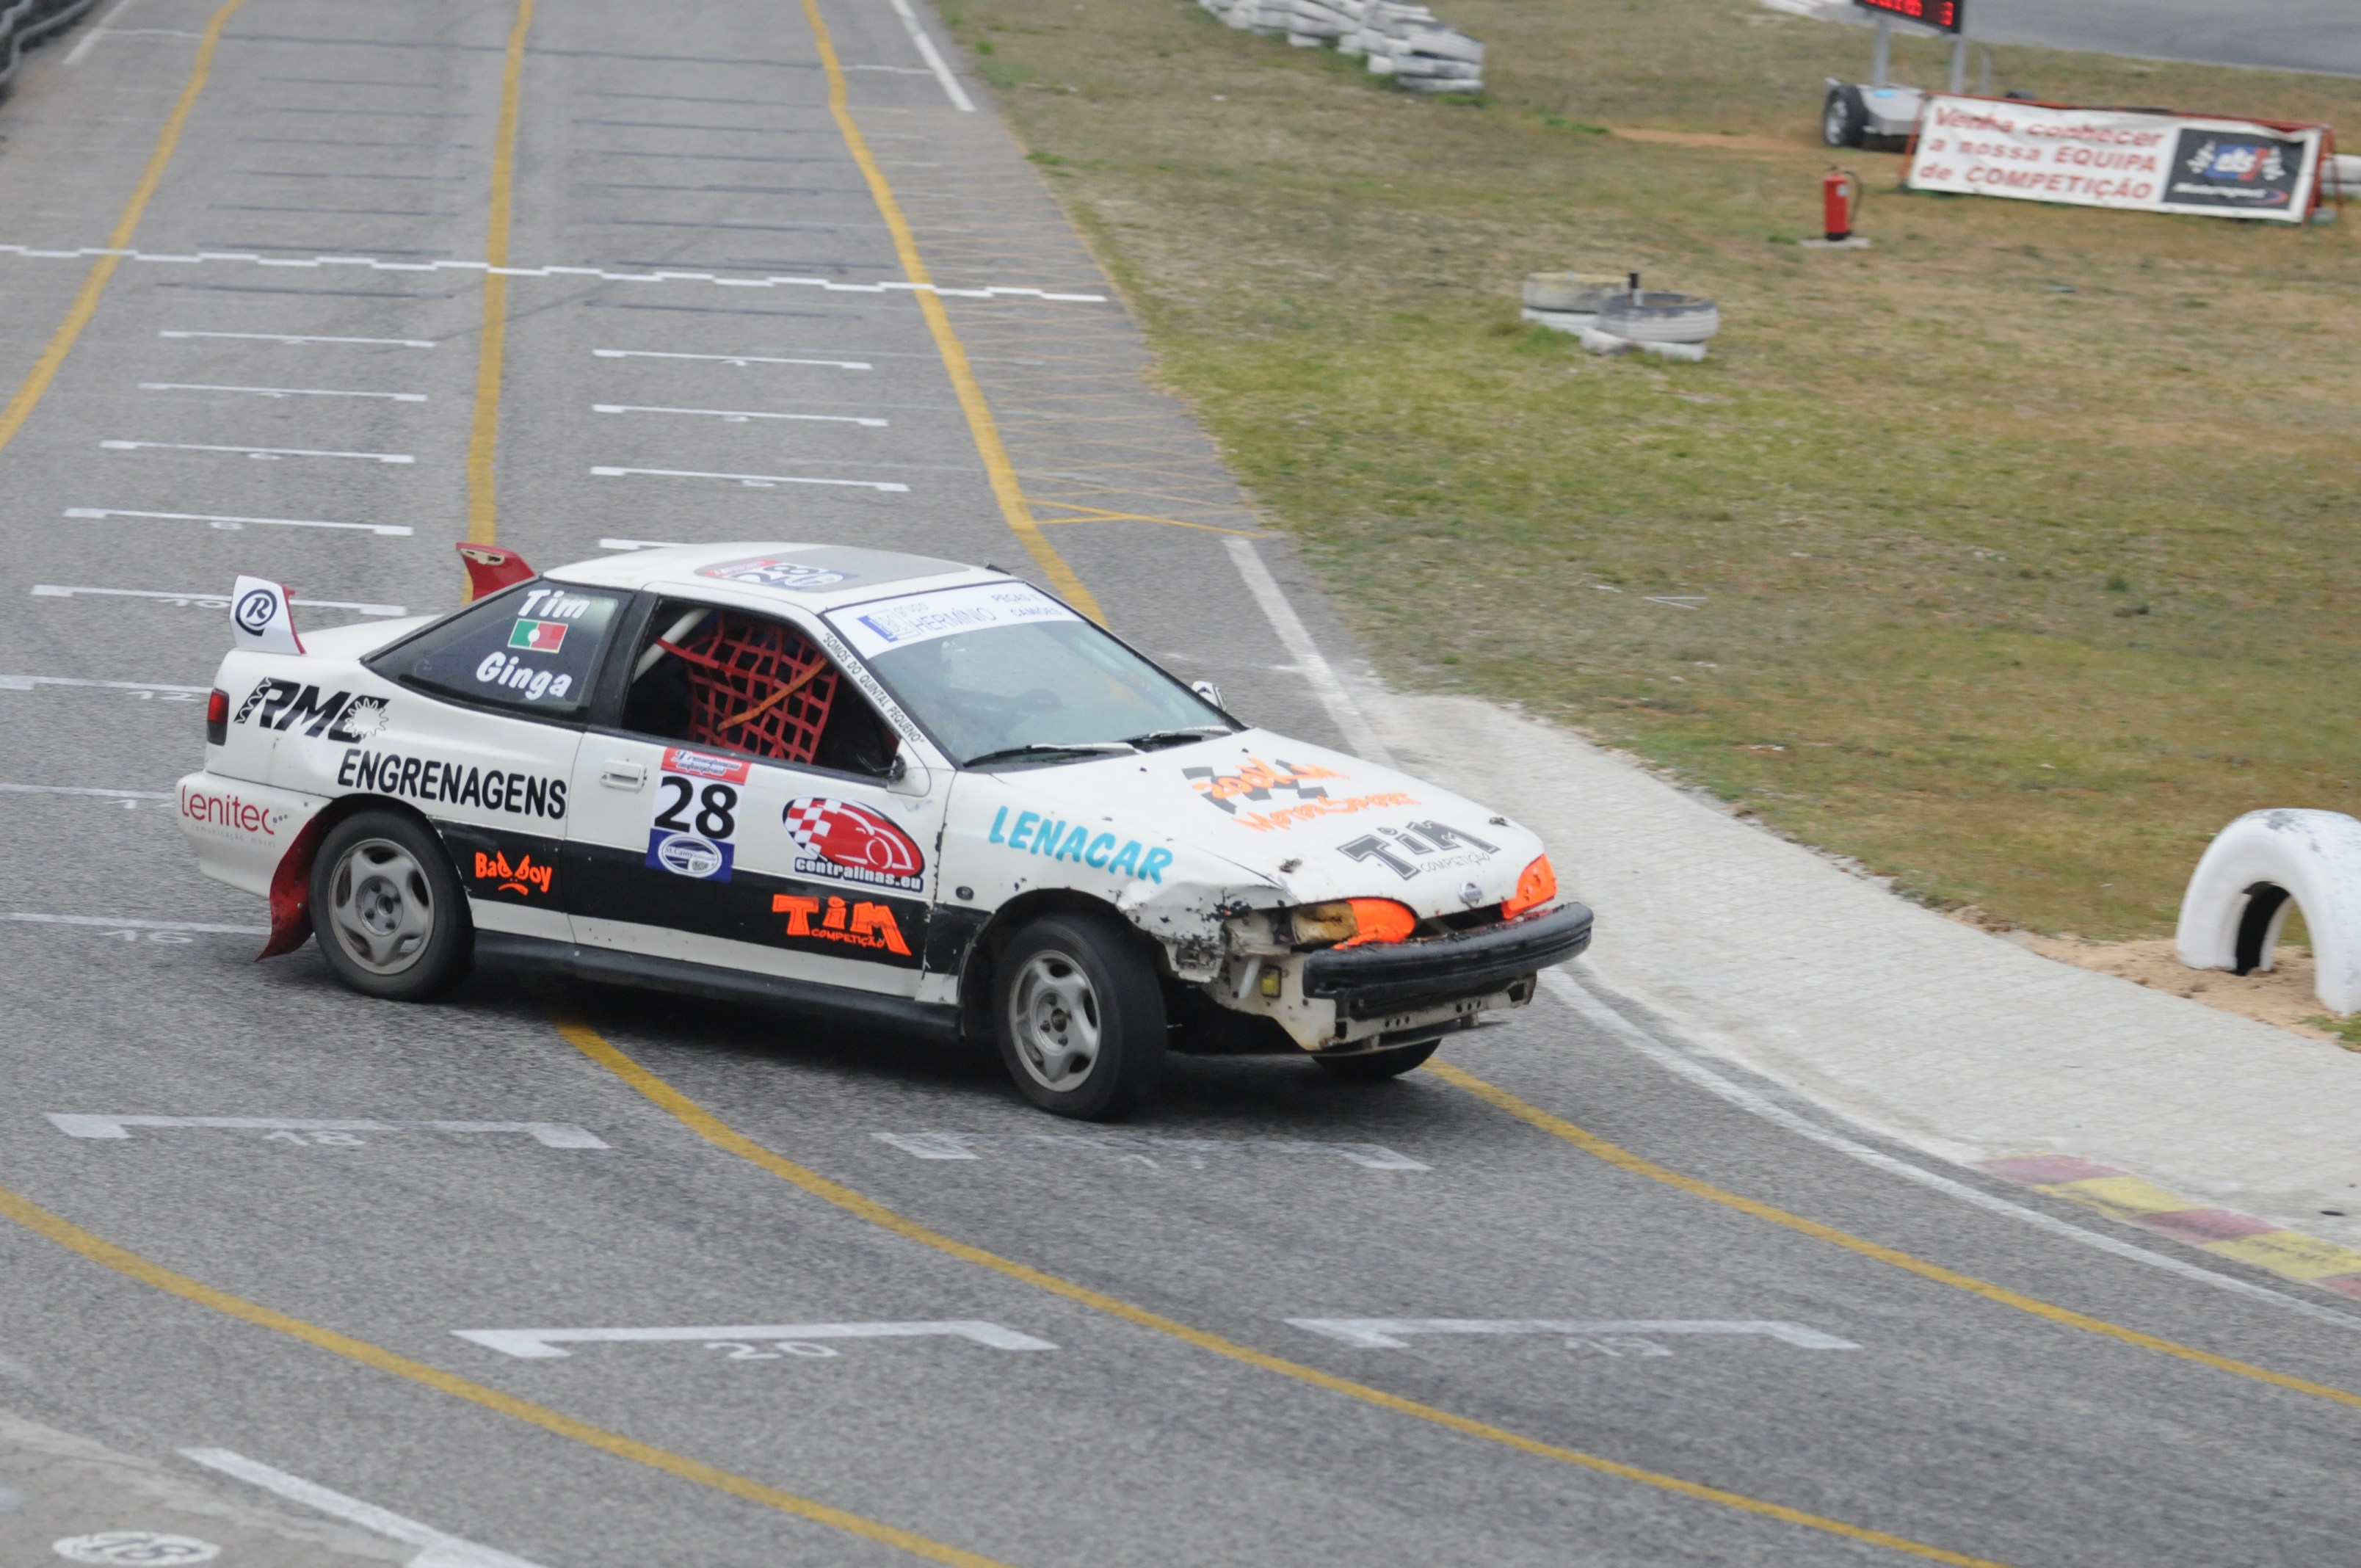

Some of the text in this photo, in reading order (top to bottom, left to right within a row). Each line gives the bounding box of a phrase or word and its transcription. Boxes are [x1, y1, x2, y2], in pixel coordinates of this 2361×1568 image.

[1934, 107, 2164, 147] Venha conhecer
[1929, 138, 2157, 173] a nossa EQUIPA
[1919, 162, 2153, 200] de COMPETIÇÃO
[518, 589, 590, 619] Tim
[910, 606, 997, 634] HERMÍNIO
[476, 651, 573, 700] Ginga
[847, 661, 862, 675] DO
[859, 675, 888, 708] QUINTAL
[338, 748, 567, 820] ENGRENAGENS
[654, 776, 738, 840] 28
[989, 805, 1173, 884] LENACAR
[795, 858, 921, 890] centralinas.eu
[810, 928, 887, 948] COMPETIÇÃO
[703, 1340, 838, 1360] 20
